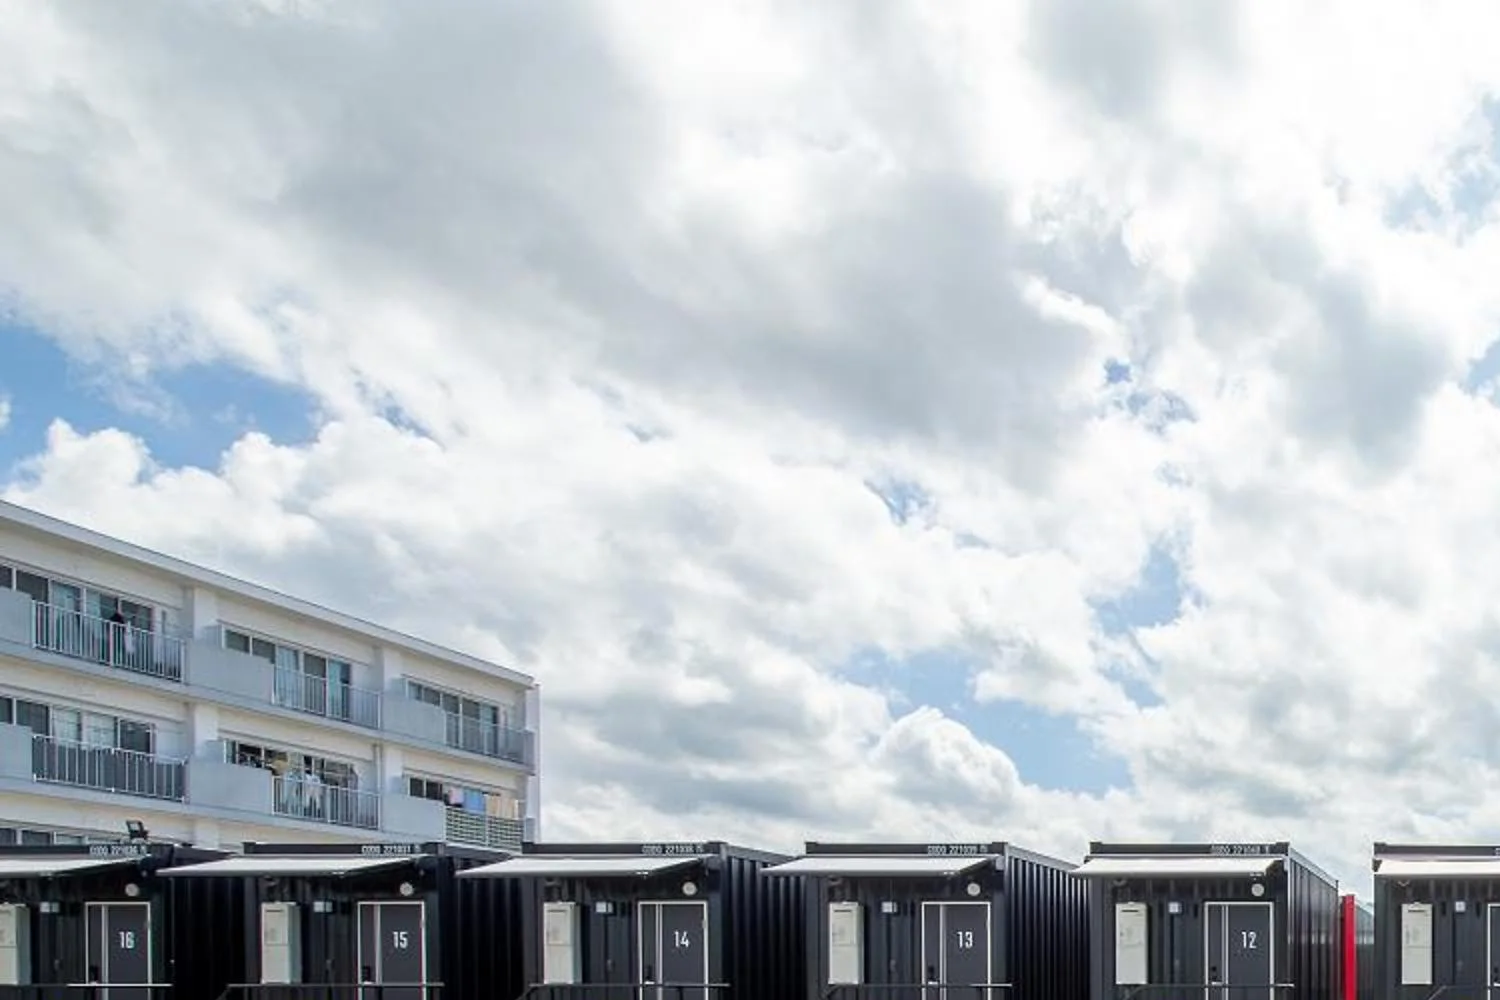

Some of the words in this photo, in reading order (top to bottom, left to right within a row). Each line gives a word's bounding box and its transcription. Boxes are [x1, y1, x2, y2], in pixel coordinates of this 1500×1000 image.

[394, 932, 407, 948] 15
[674, 931, 689, 948] 14
[958, 932, 972, 948] 13
[1242, 932, 1256, 948] 12
